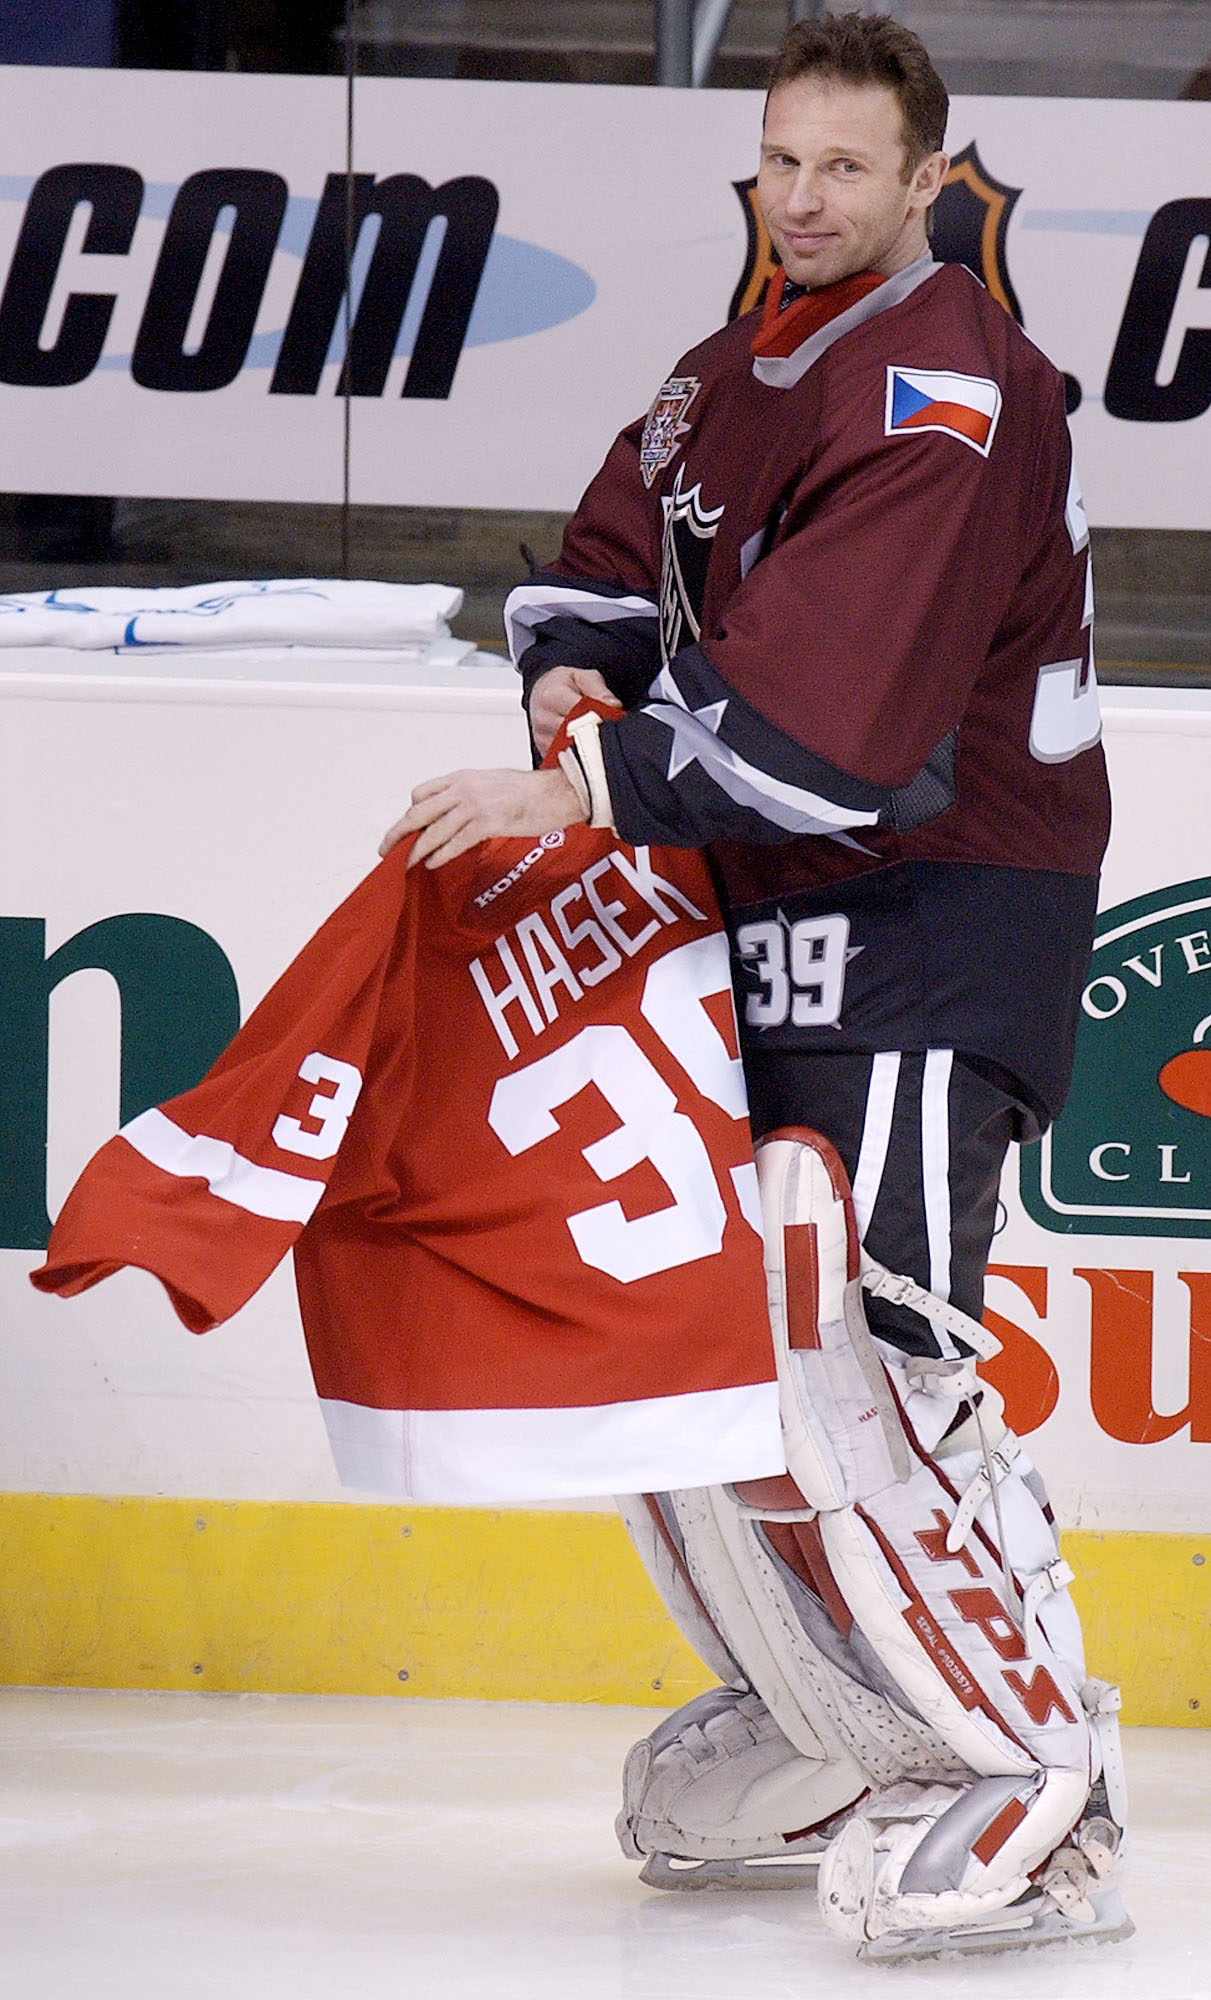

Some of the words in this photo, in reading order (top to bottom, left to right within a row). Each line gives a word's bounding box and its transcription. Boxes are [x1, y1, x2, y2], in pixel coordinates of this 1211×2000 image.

[473, 846, 545, 909] KOHO
[468, 845, 709, 1061] HASEK
[735, 911, 851, 1028] 39
[271, 1050, 364, 1161] 3
[1088, 1142, 1191, 1184] CL
[913, 1508, 1078, 1725] TPS
